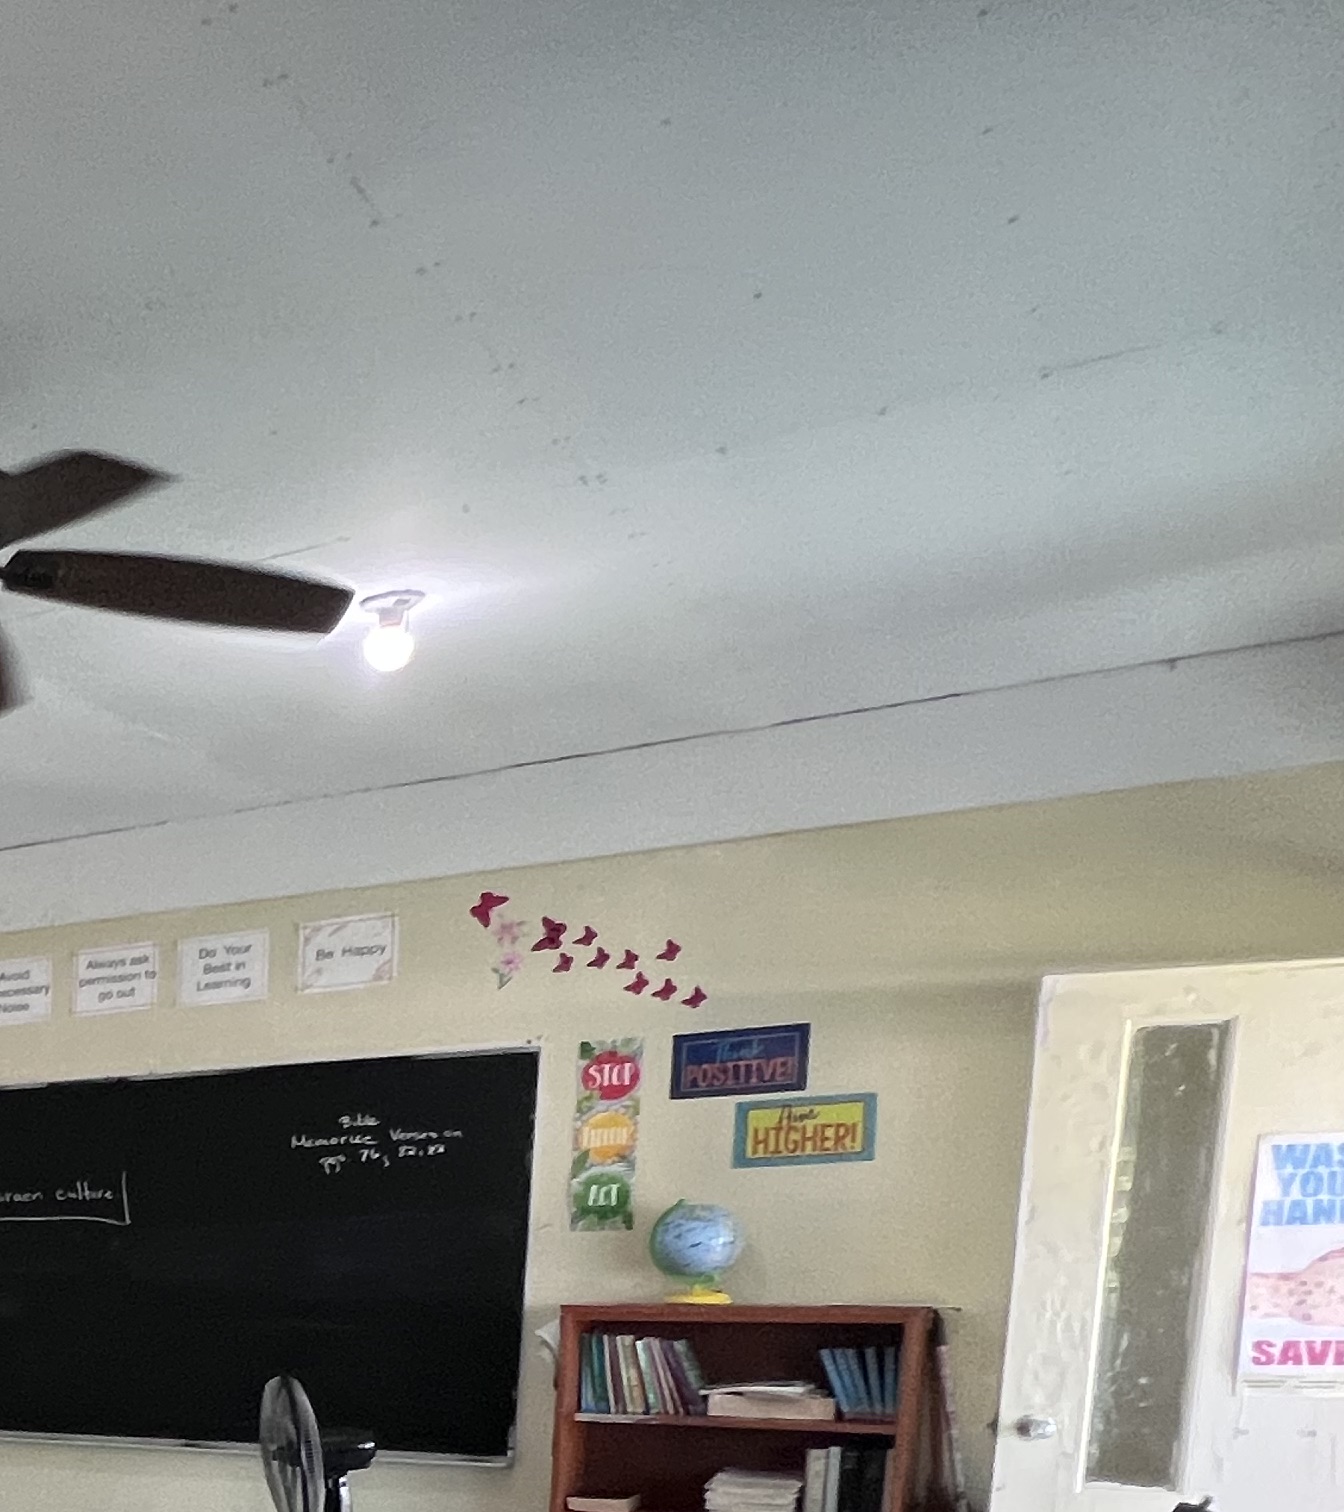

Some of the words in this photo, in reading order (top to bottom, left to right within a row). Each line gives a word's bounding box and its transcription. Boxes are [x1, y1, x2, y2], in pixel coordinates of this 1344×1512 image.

[198, 948, 217, 960] Do
[223, 944, 253, 956] Your
[315, 949, 335, 961] Be
[341, 944, 388, 958] Happy
[86, 958, 127, 970] Always
[203, 962, 232, 975] Best
[78, 971, 141, 988] permission
[196, 977, 252, 992] Learning
[751, 1121, 859, 1155] HIGHER!
